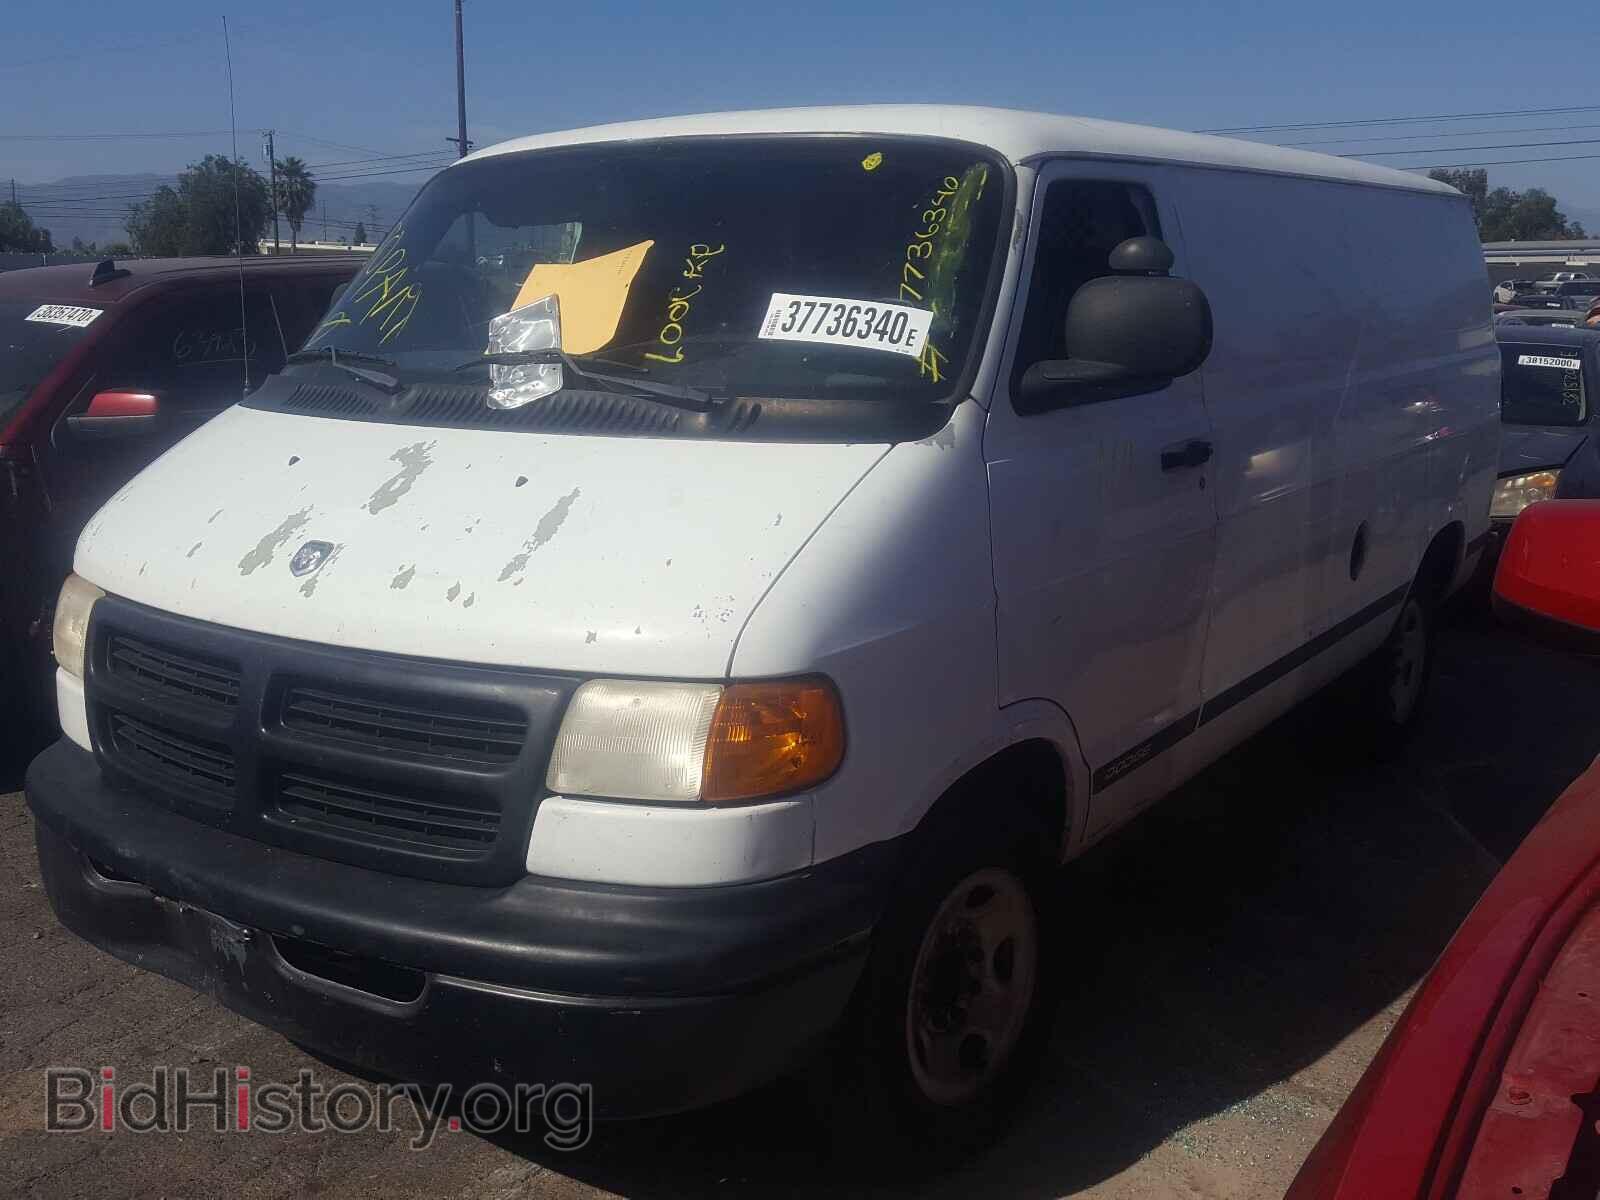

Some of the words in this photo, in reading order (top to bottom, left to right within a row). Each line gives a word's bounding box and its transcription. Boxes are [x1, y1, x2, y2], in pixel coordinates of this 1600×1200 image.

[781, 301, 908, 345] 37736340
[905, 329, 918, 347] E
[1525, 356, 1573, 367] 38152000
